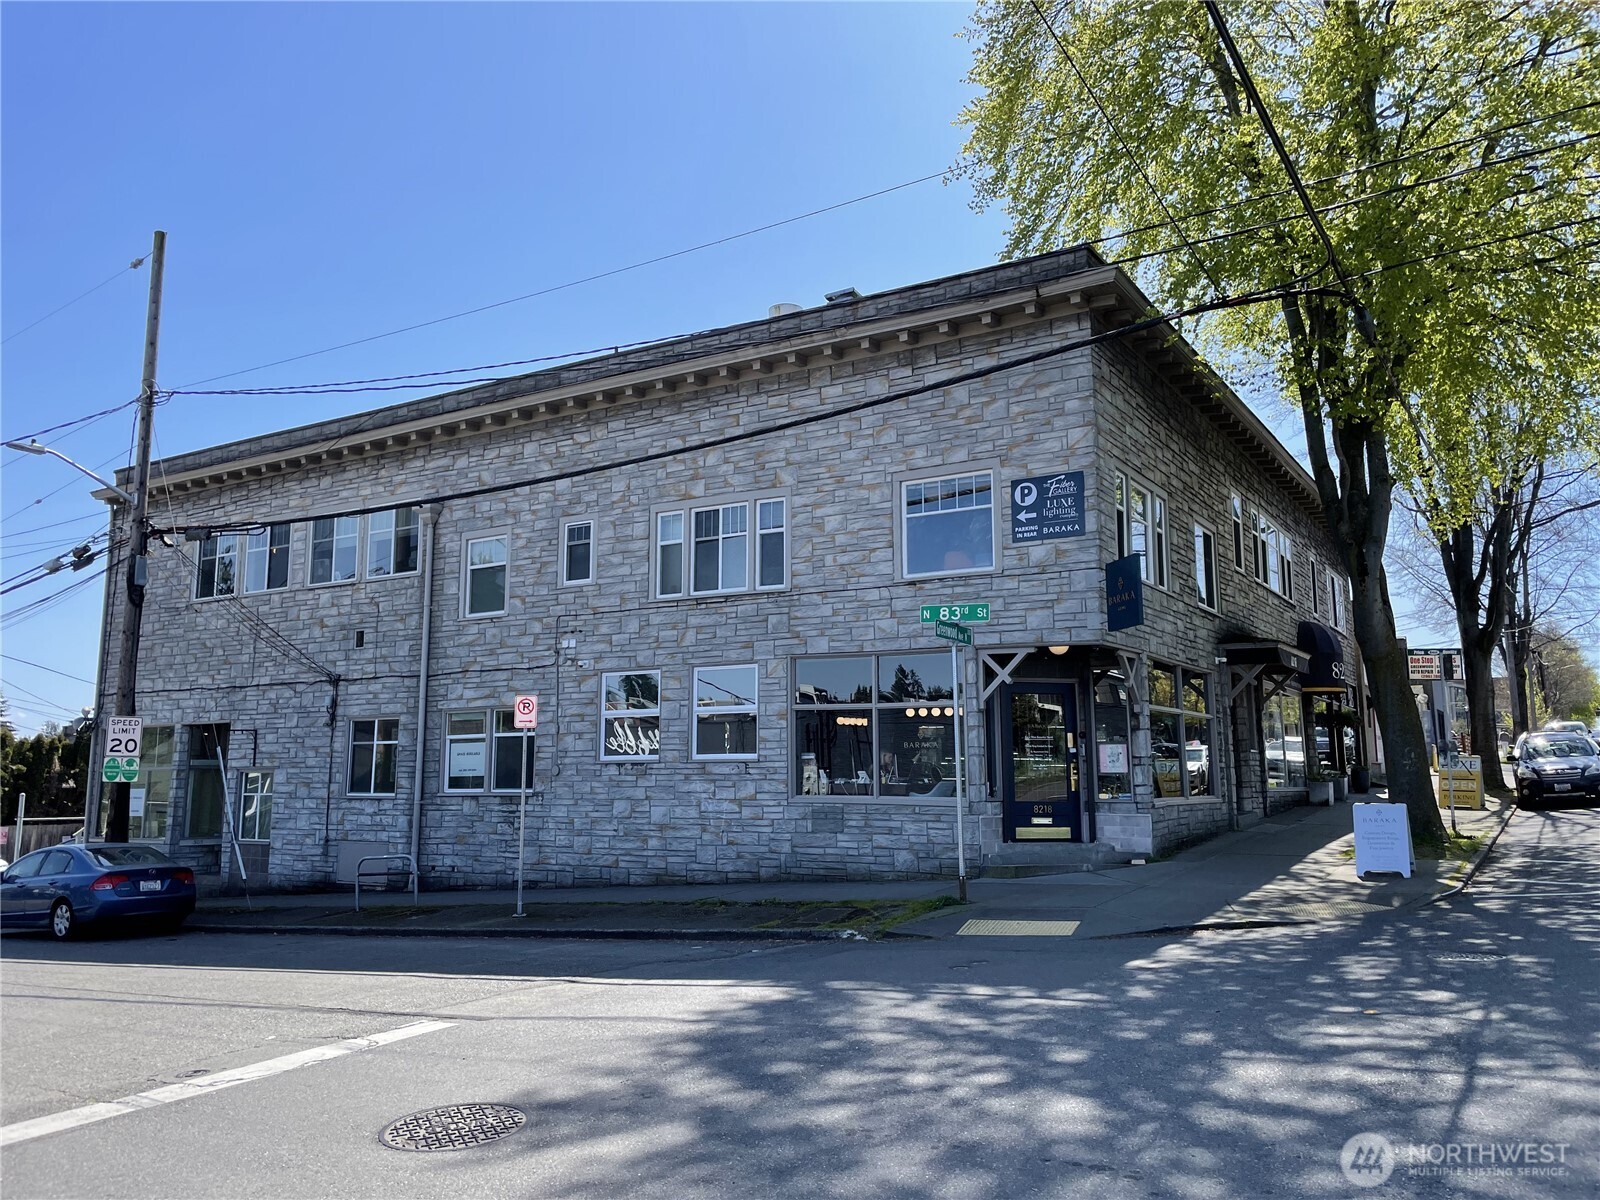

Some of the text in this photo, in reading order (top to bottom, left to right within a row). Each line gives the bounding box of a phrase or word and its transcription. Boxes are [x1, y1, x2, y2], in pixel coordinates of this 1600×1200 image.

[1020, 485, 1033, 503] P
[1053, 486, 1077, 495] GALLERY
[1047, 497, 1075, 508] LUXE
[1043, 507, 1076, 518] lighting
[1043, 524, 1080, 534] BARAKA
[1108, 590, 1135, 606] BARAKA
[923, 606, 987, 620] N 83rd St
[109, 738, 138, 753] 20
[903, 741, 940, 749] BARAKA
[1441, 781, 1477, 790] OPEN
